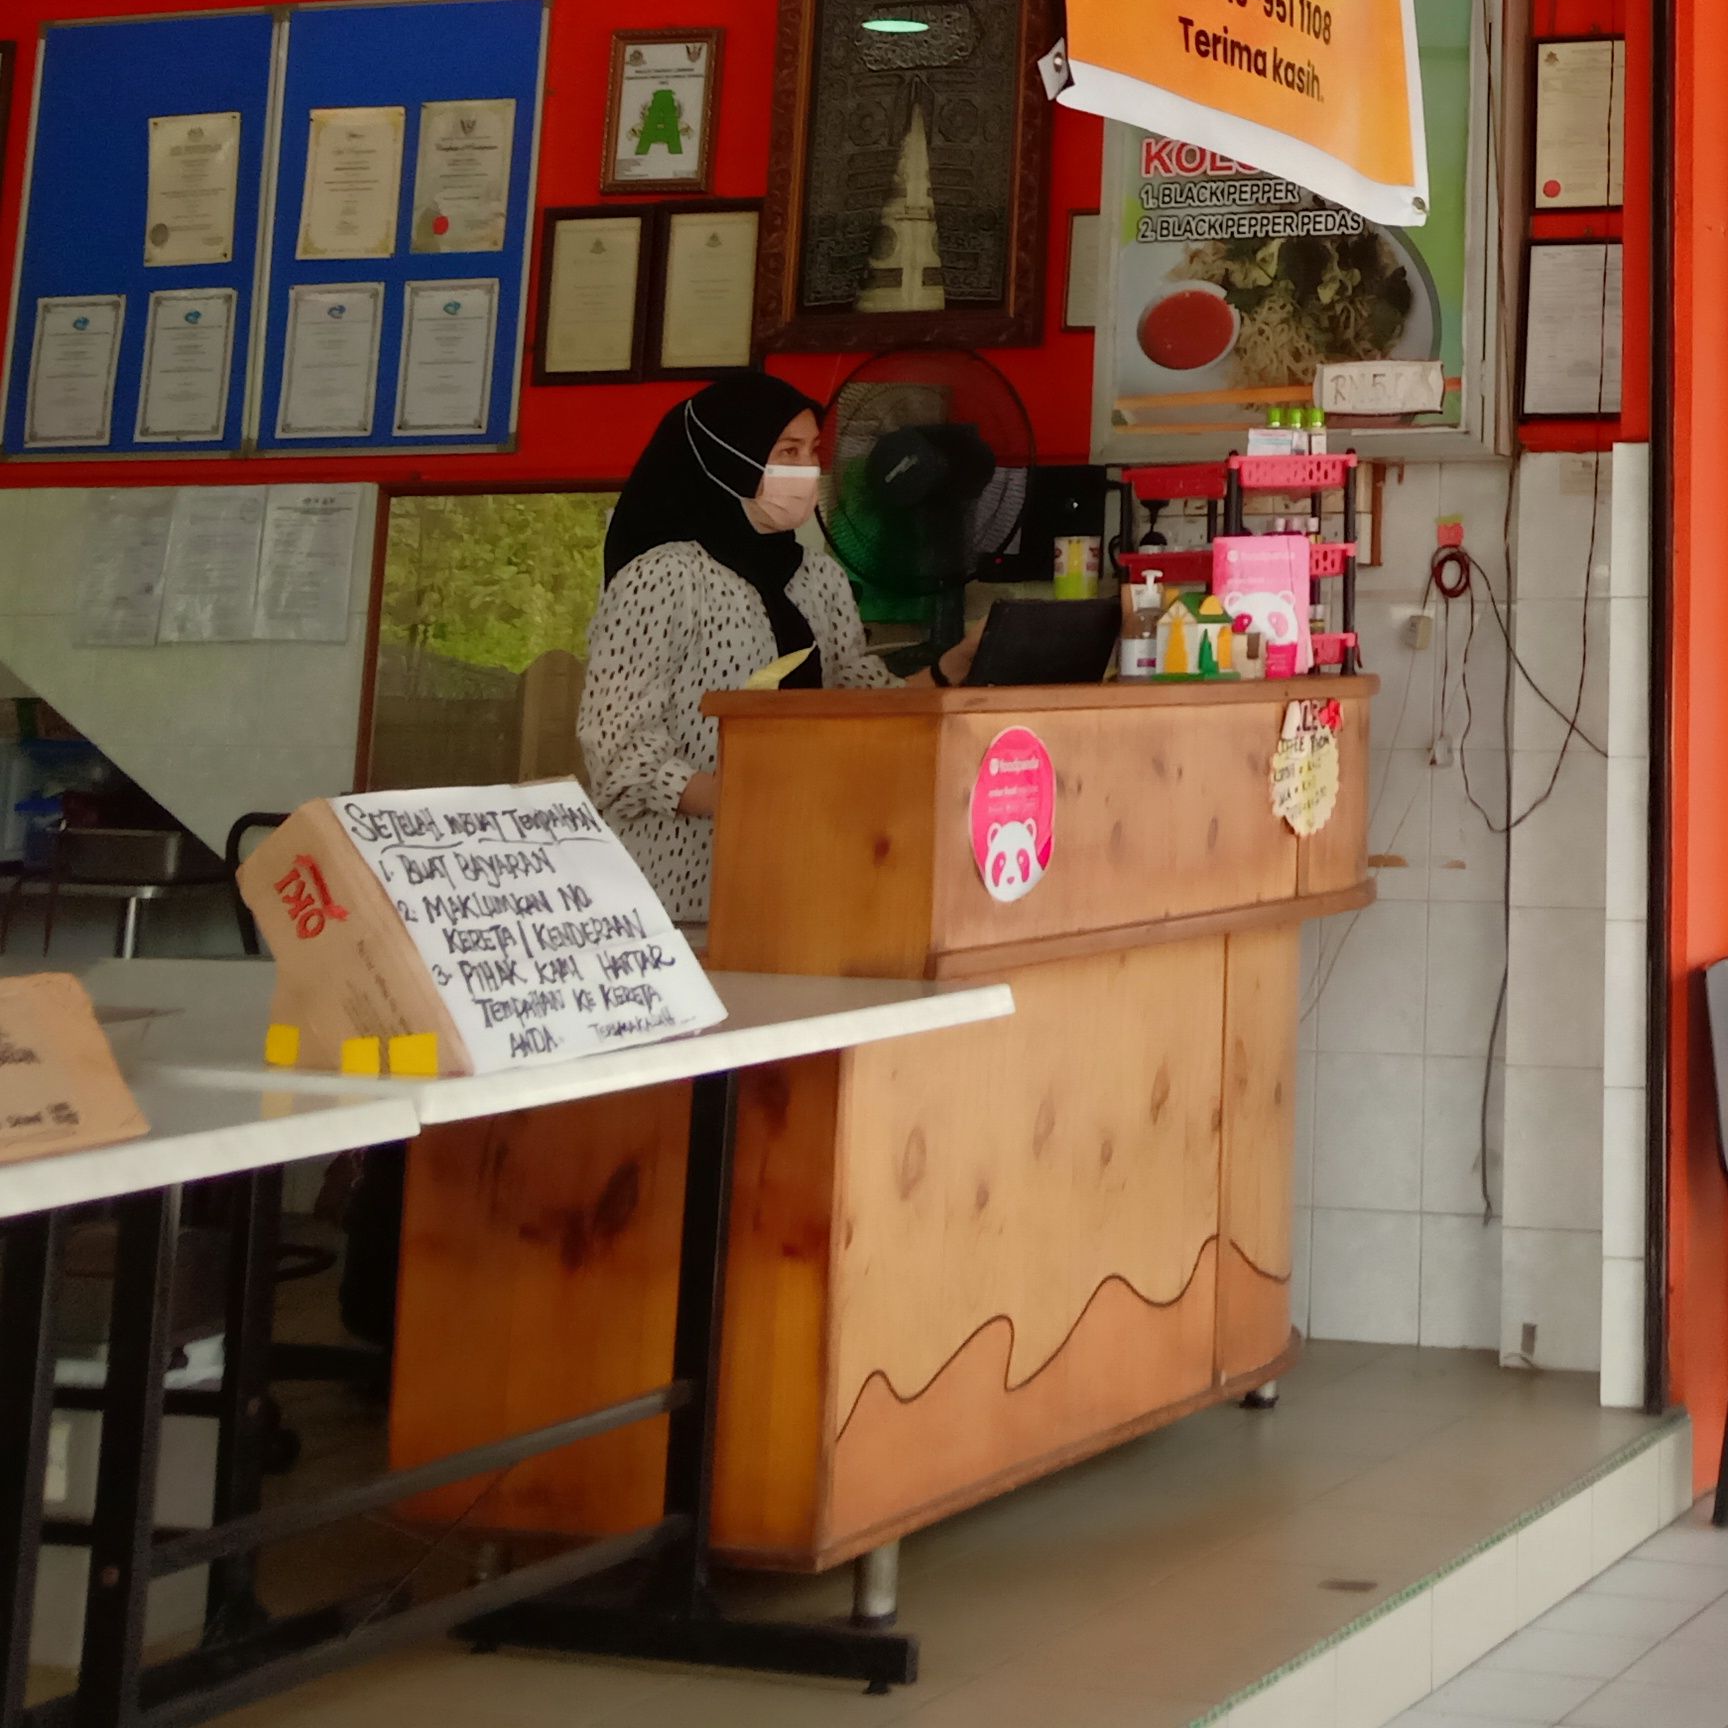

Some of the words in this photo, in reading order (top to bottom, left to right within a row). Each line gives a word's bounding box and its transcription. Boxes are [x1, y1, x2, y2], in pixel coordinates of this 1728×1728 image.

[1178, 15, 1267, 79] Terima
[1273, 50, 1325, 104] kasih.
[1142, 138, 1262, 177] KOL
[1158, 181, 1225, 209] BLACK
[1225, 178, 1299, 206] PEPPER
[1138, 216, 1156, 242] 2.
[1156, 213, 1223, 241] BLACK
[1223, 211, 1299, 239] PEPPER
[1300, 209, 1363, 237] PEDAS
[345, 803, 445, 845] SETELAH
[503, 802, 602, 845] TEMPAHAN
[397, 854, 456, 890] BUAT
[453, 847, 557, 889] BAYARAN
[423, 890, 553, 925] MAKLUMKAN
[442, 924, 517, 960] KERETA
[534, 908, 647, 952] KENDERAAN
[457, 957, 527, 995] PIHAK
[472, 989, 565, 1028] TEMPAHAN
[572, 989, 597, 1013] KE
[600, 984, 662, 1014] KERETA
